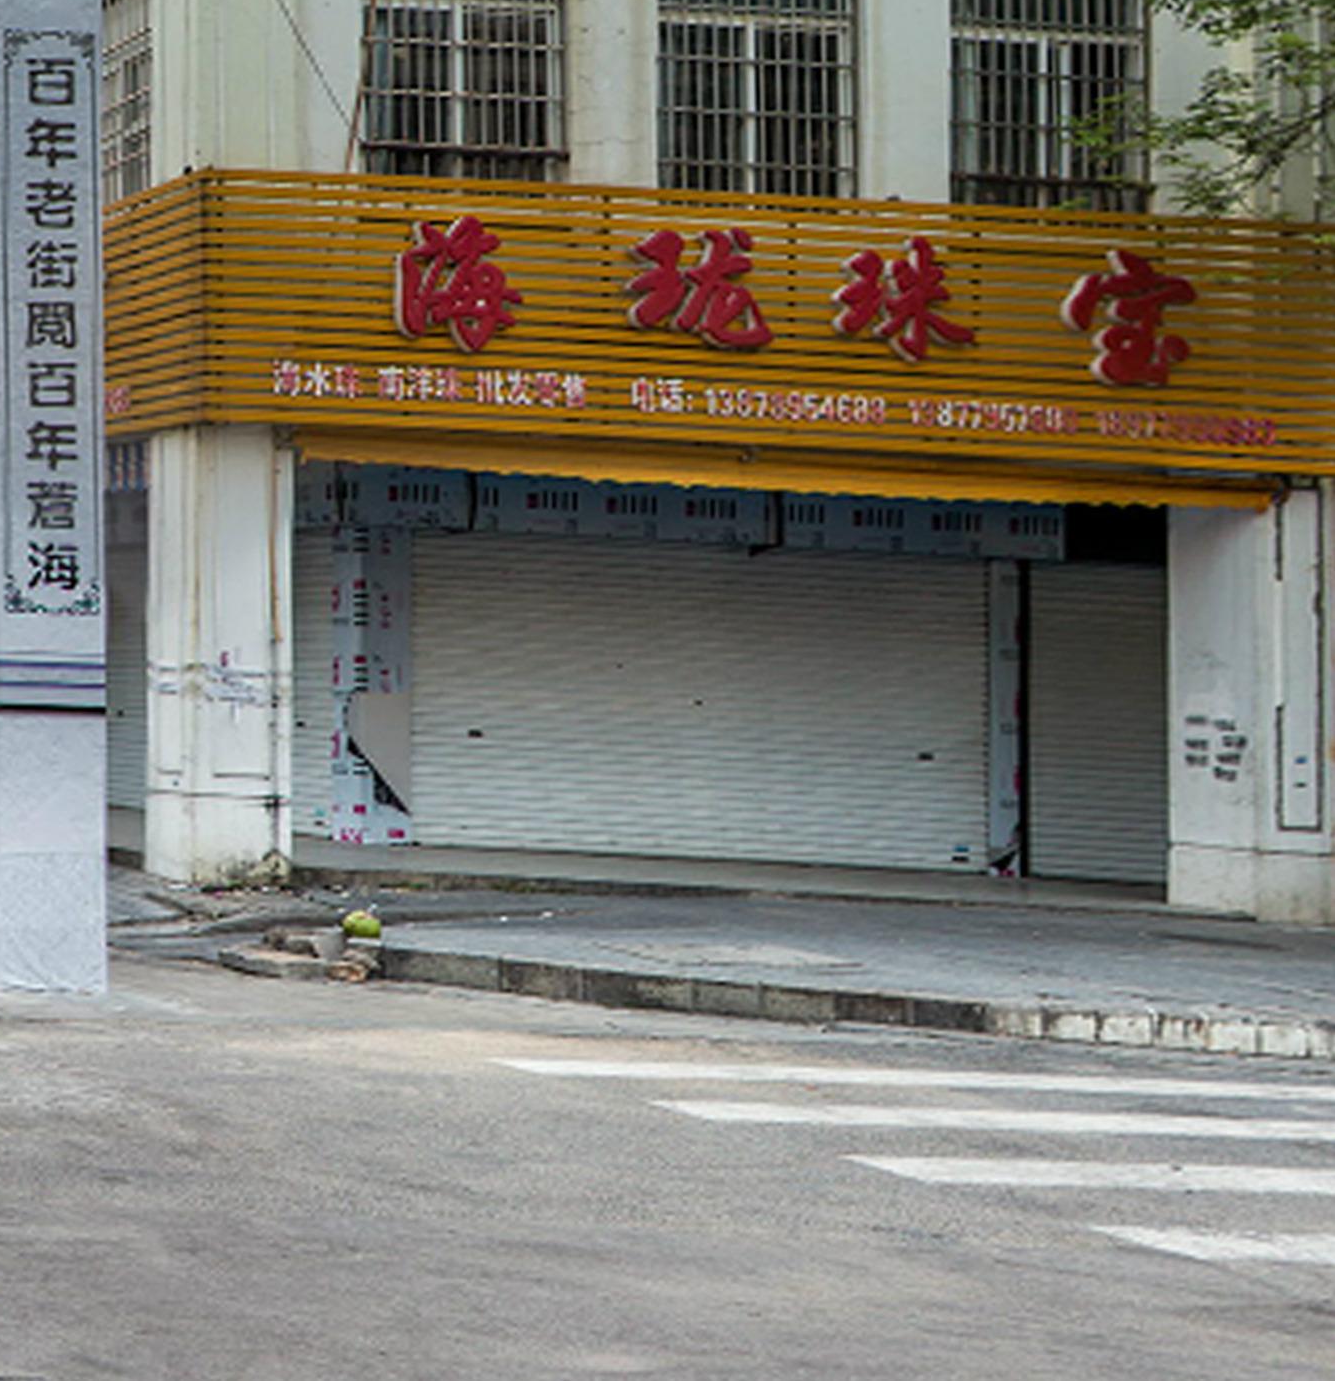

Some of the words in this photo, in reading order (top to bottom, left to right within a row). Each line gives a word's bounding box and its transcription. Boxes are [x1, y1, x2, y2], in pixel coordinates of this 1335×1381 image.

[272, 359, 362, 399] 海水珠
[377, 364, 462, 402] 南洋珠
[475, 368, 586, 409] 批发零售
